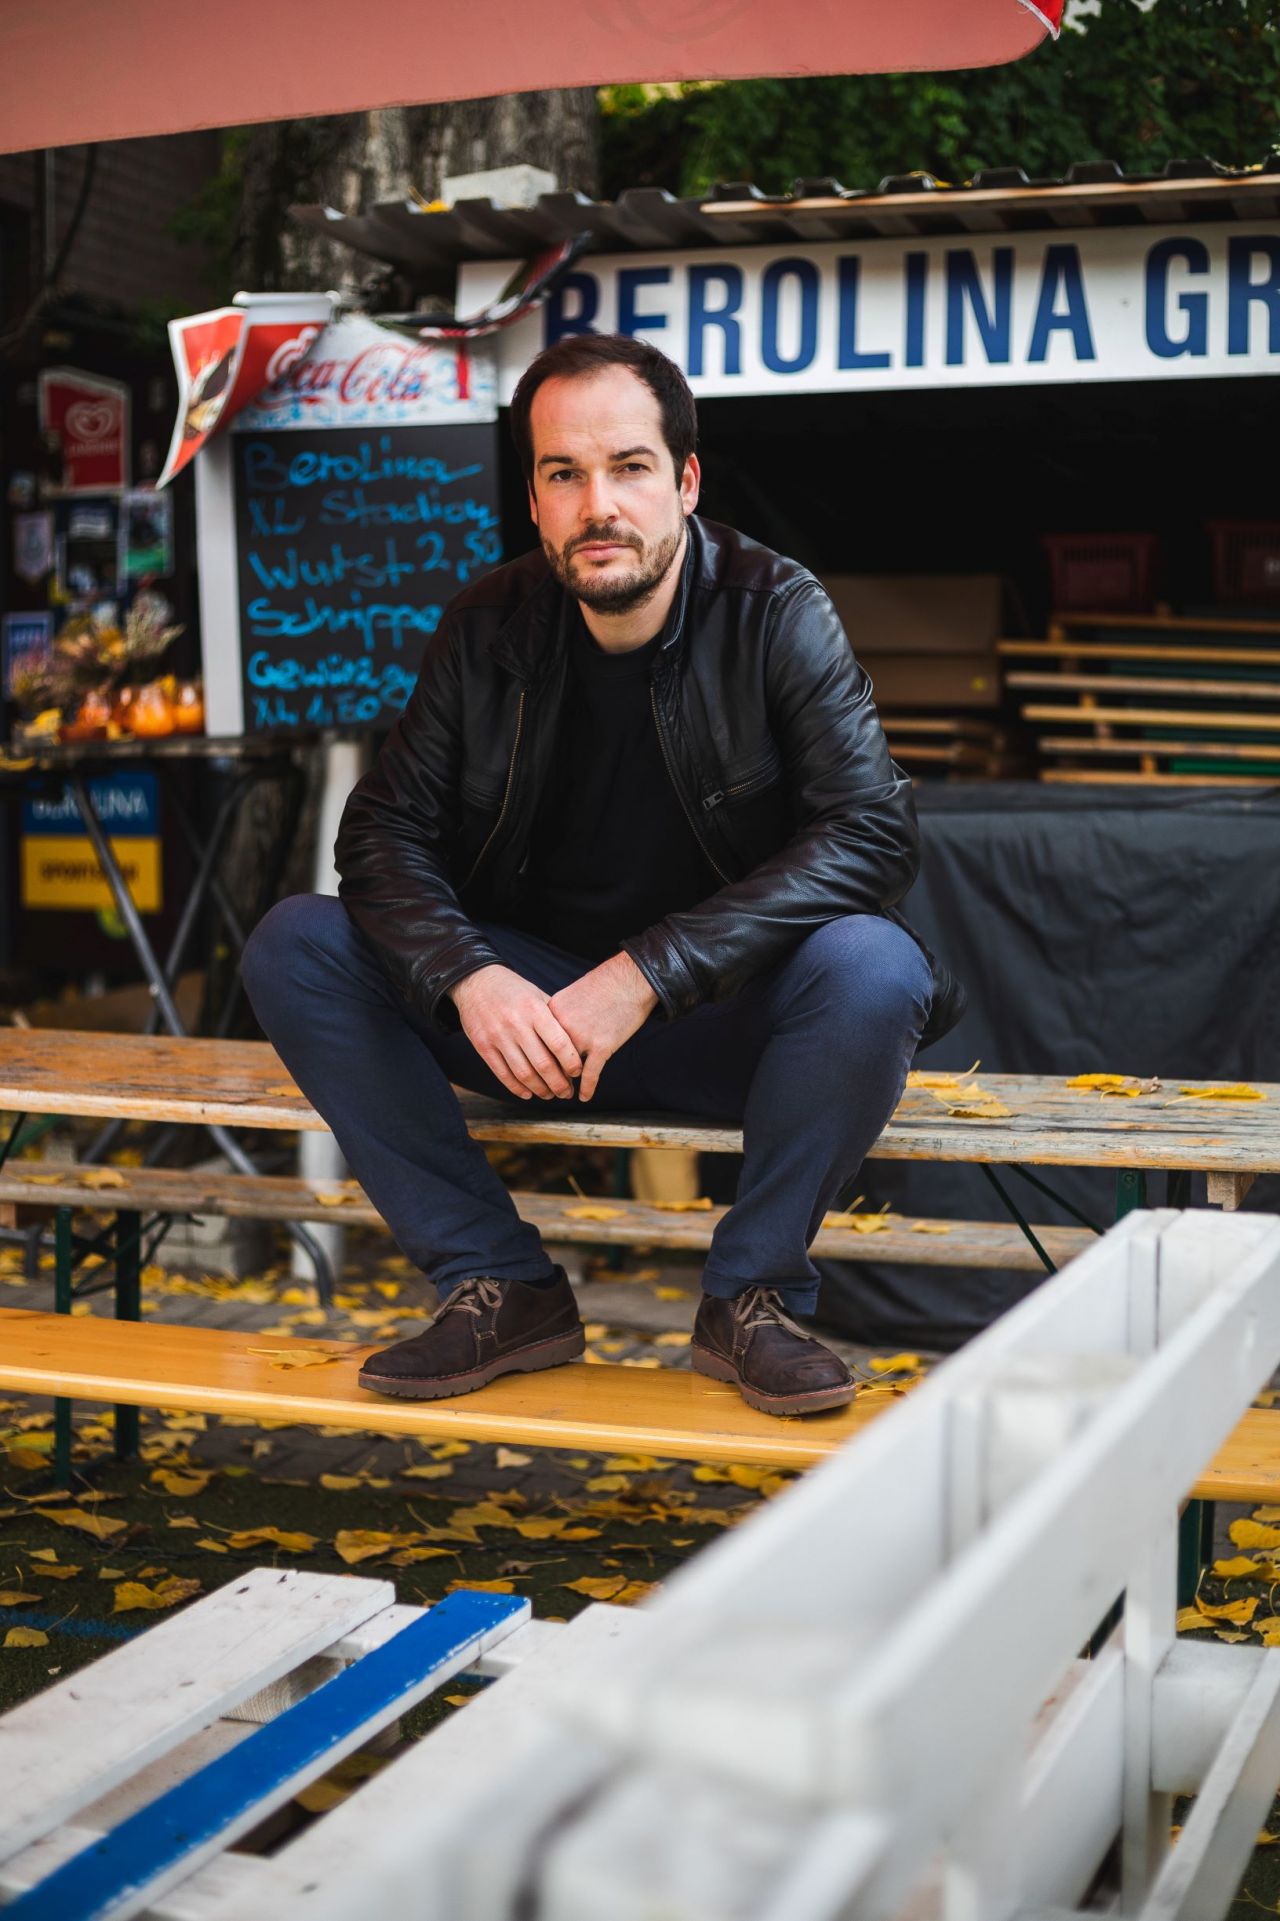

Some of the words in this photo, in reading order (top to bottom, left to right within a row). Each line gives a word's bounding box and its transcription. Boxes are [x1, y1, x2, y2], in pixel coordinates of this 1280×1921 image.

[545, 243, 1097, 378] BEROLINA
[1143, 234, 1280, 362] GR
[255, 341, 437, 410] ca-Cola
[248, 537, 414, 590] Wurst
